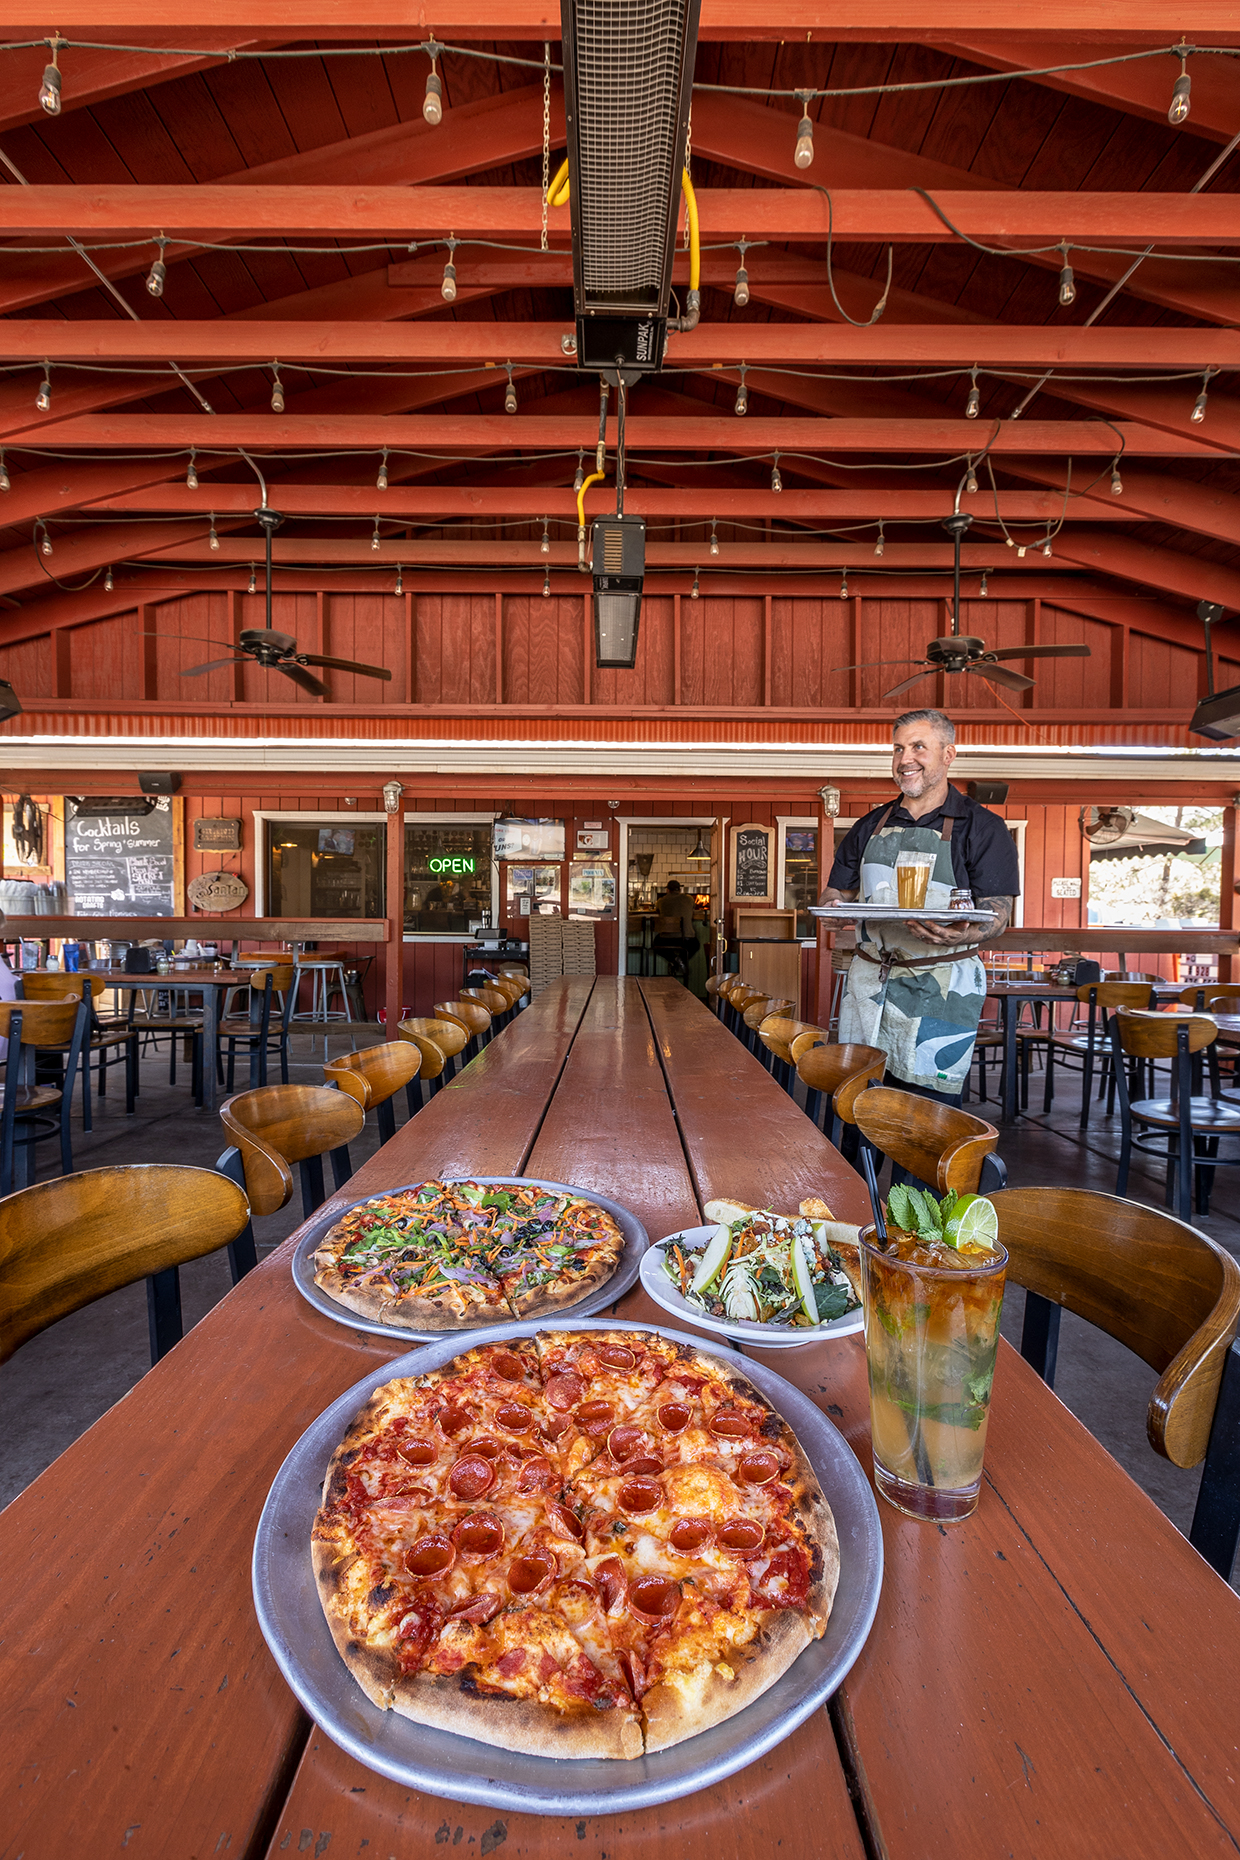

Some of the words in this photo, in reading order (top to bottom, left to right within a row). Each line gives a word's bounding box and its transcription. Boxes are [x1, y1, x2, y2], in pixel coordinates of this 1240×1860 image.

[636, 323, 650, 361] SUNPAK
[77, 816, 140, 837] Cocktails
[73, 837, 90, 853] for
[93, 839, 123, 853] Spring
[494, 842, 515, 852] UNS?
[739, 835, 766, 846] Social
[738, 846, 767, 864] HOUR
[429, 858, 474, 873] OPEN
